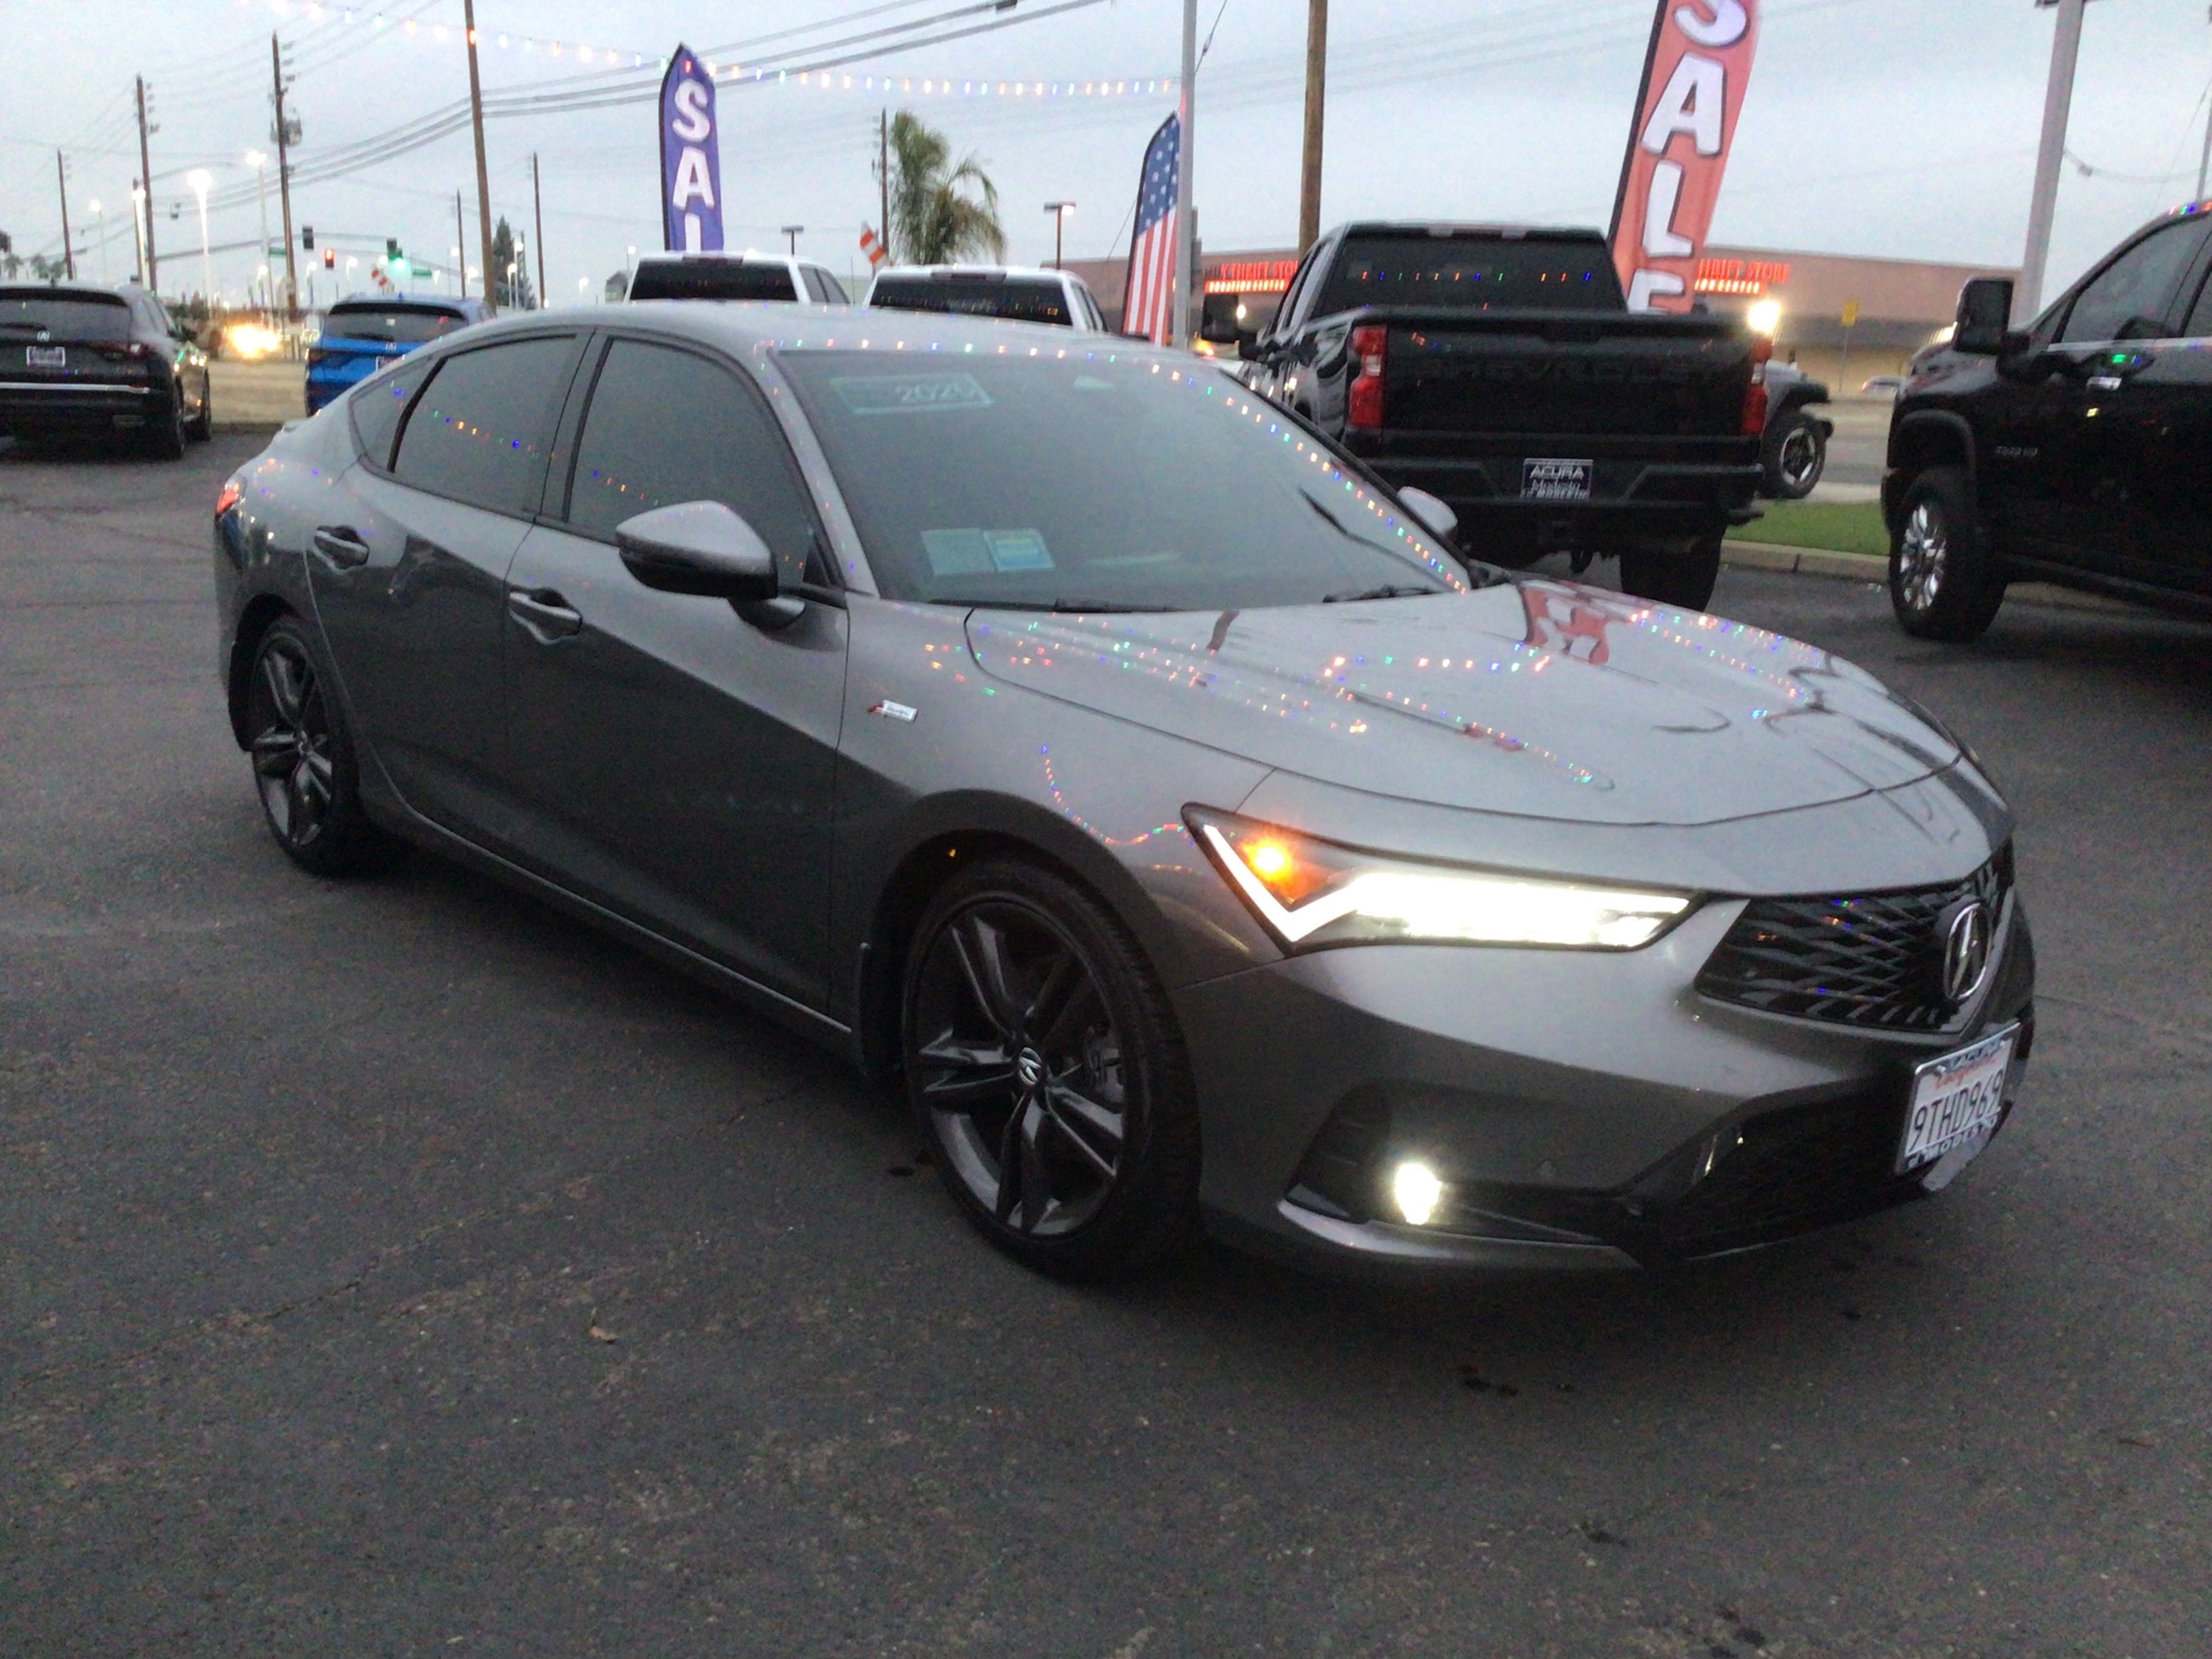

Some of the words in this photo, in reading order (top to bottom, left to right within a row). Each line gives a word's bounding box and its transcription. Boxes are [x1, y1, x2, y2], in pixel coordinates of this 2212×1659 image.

[1698, 258, 1744, 281] HRIFT
[1530, 465, 1585, 479] ACURA
[1908, 1067, 2005, 1153] 9THD969
